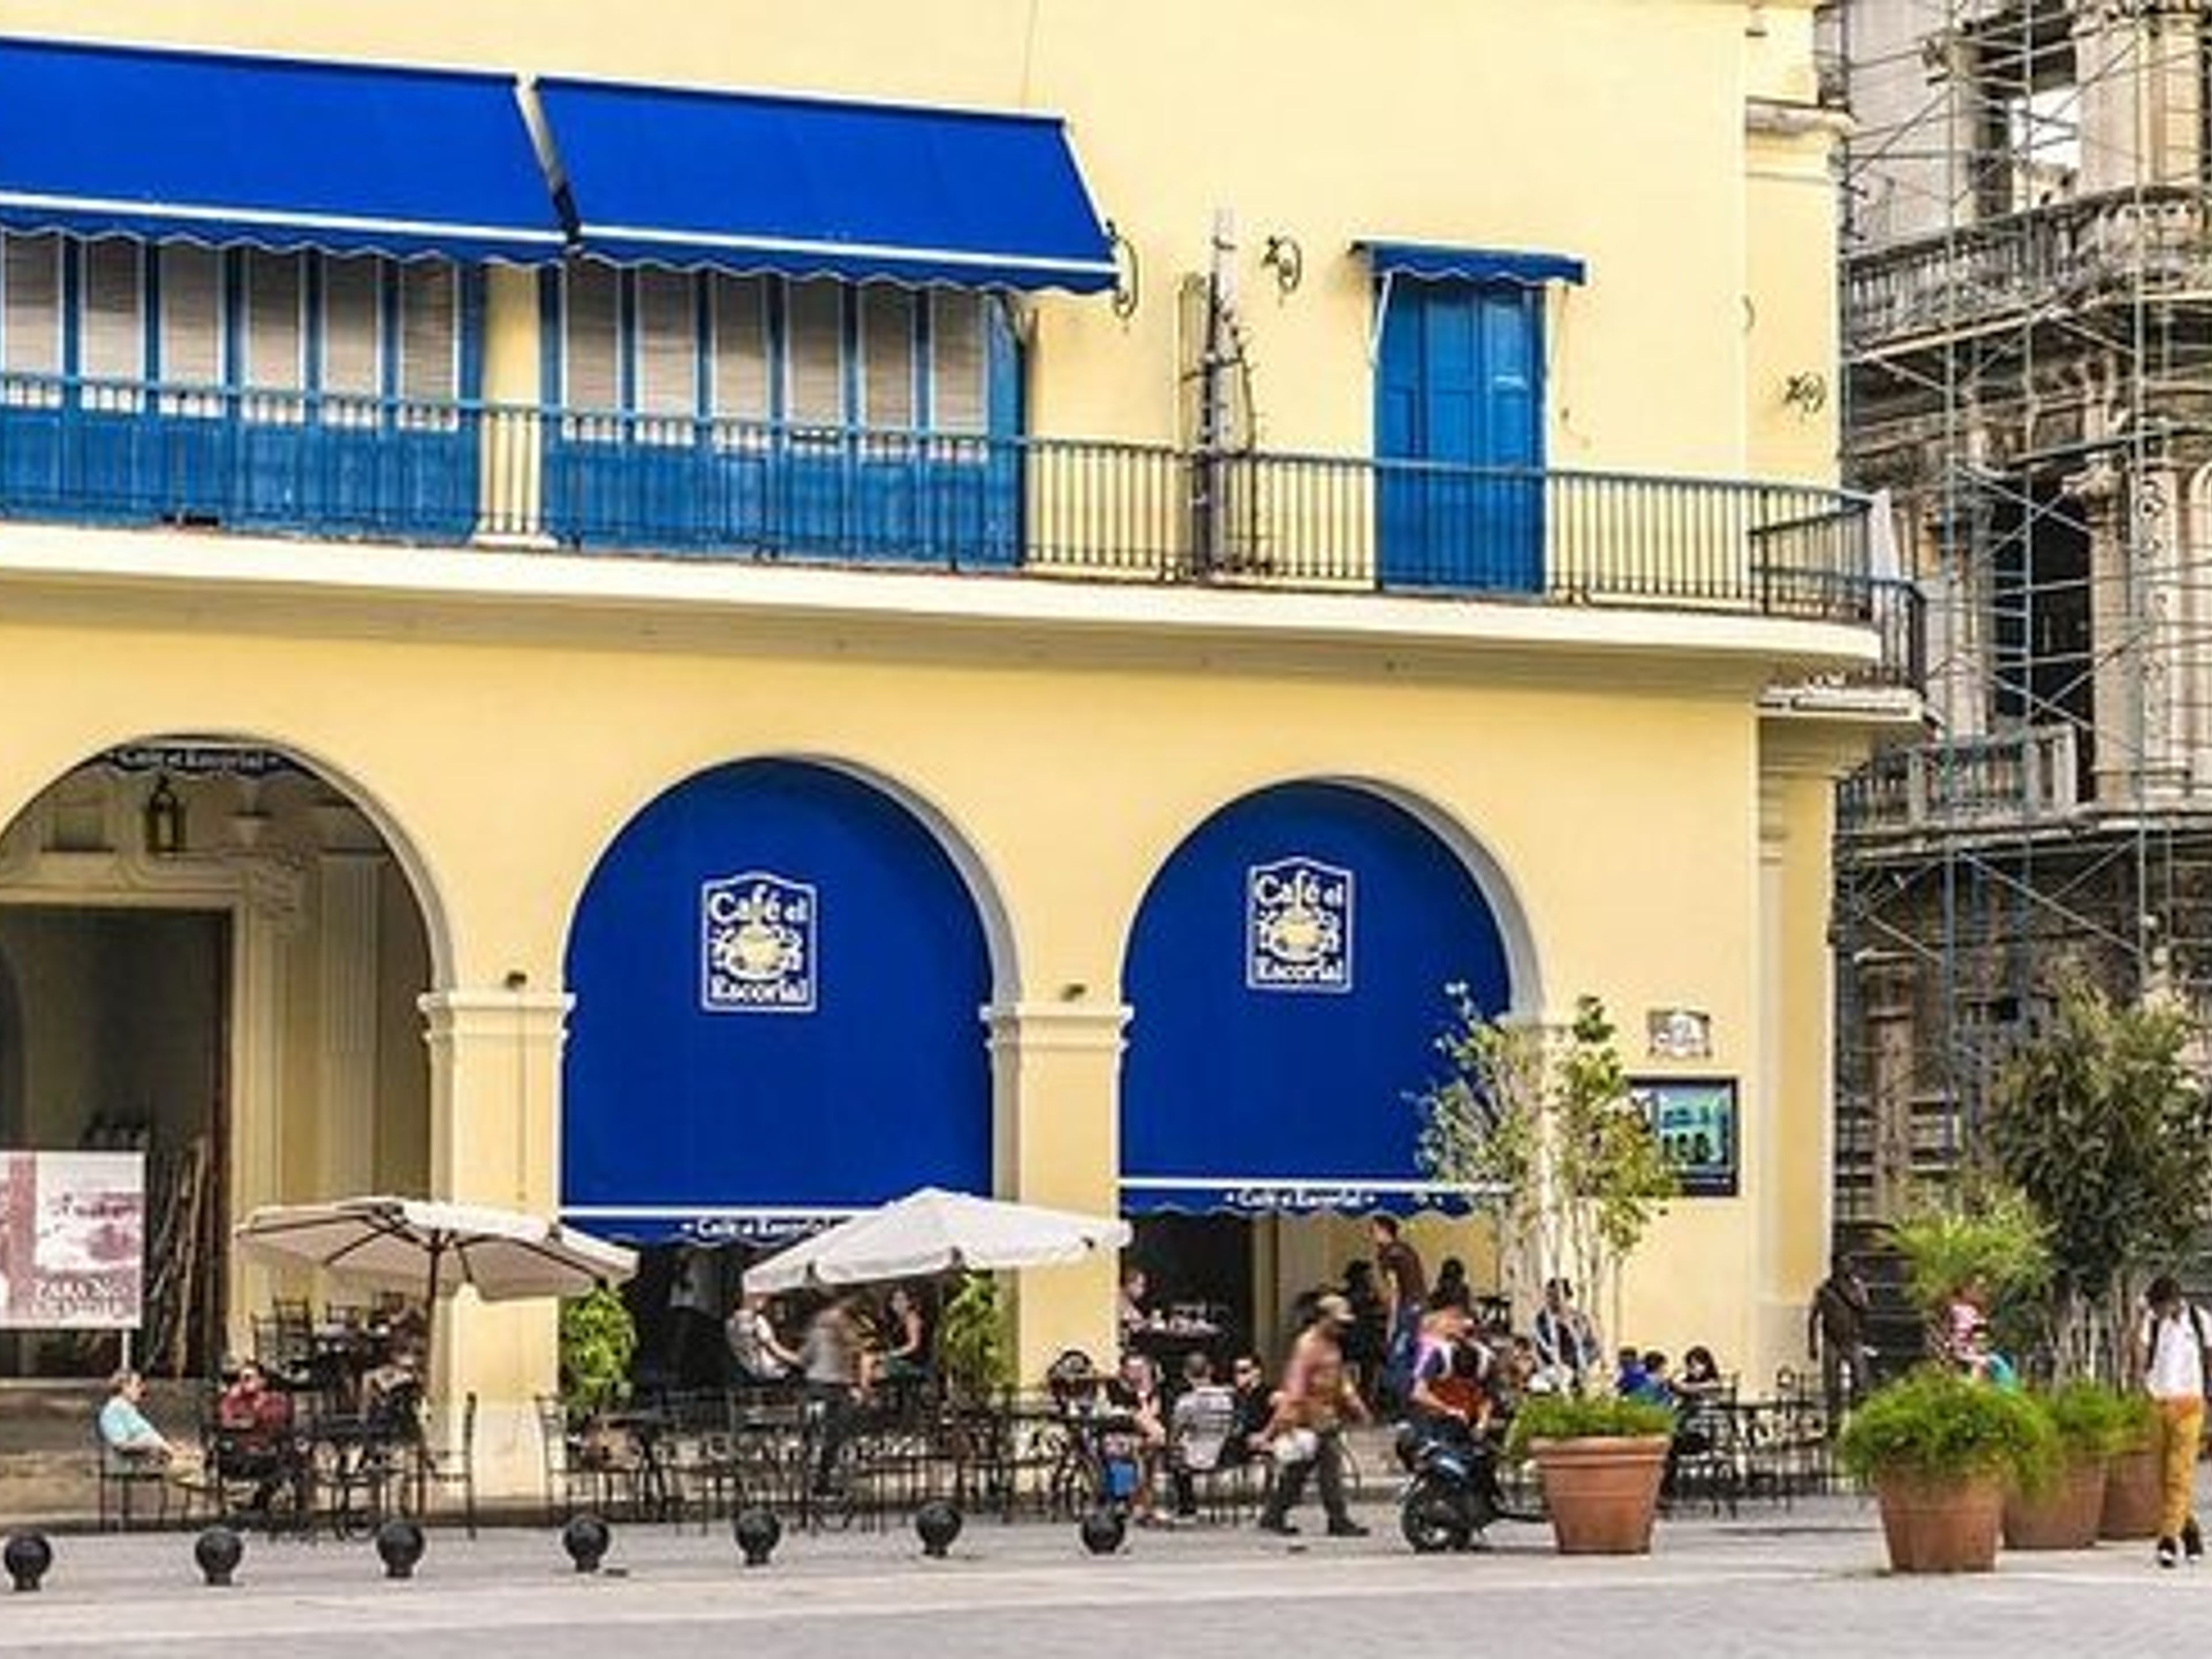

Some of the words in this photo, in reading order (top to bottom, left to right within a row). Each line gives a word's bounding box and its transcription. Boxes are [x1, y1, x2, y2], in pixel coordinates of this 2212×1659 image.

[710, 884, 780, 922] Café
[784, 896, 808, 922] el
[1253, 870, 1319, 907] Café
[1324, 883, 1343, 906] el
